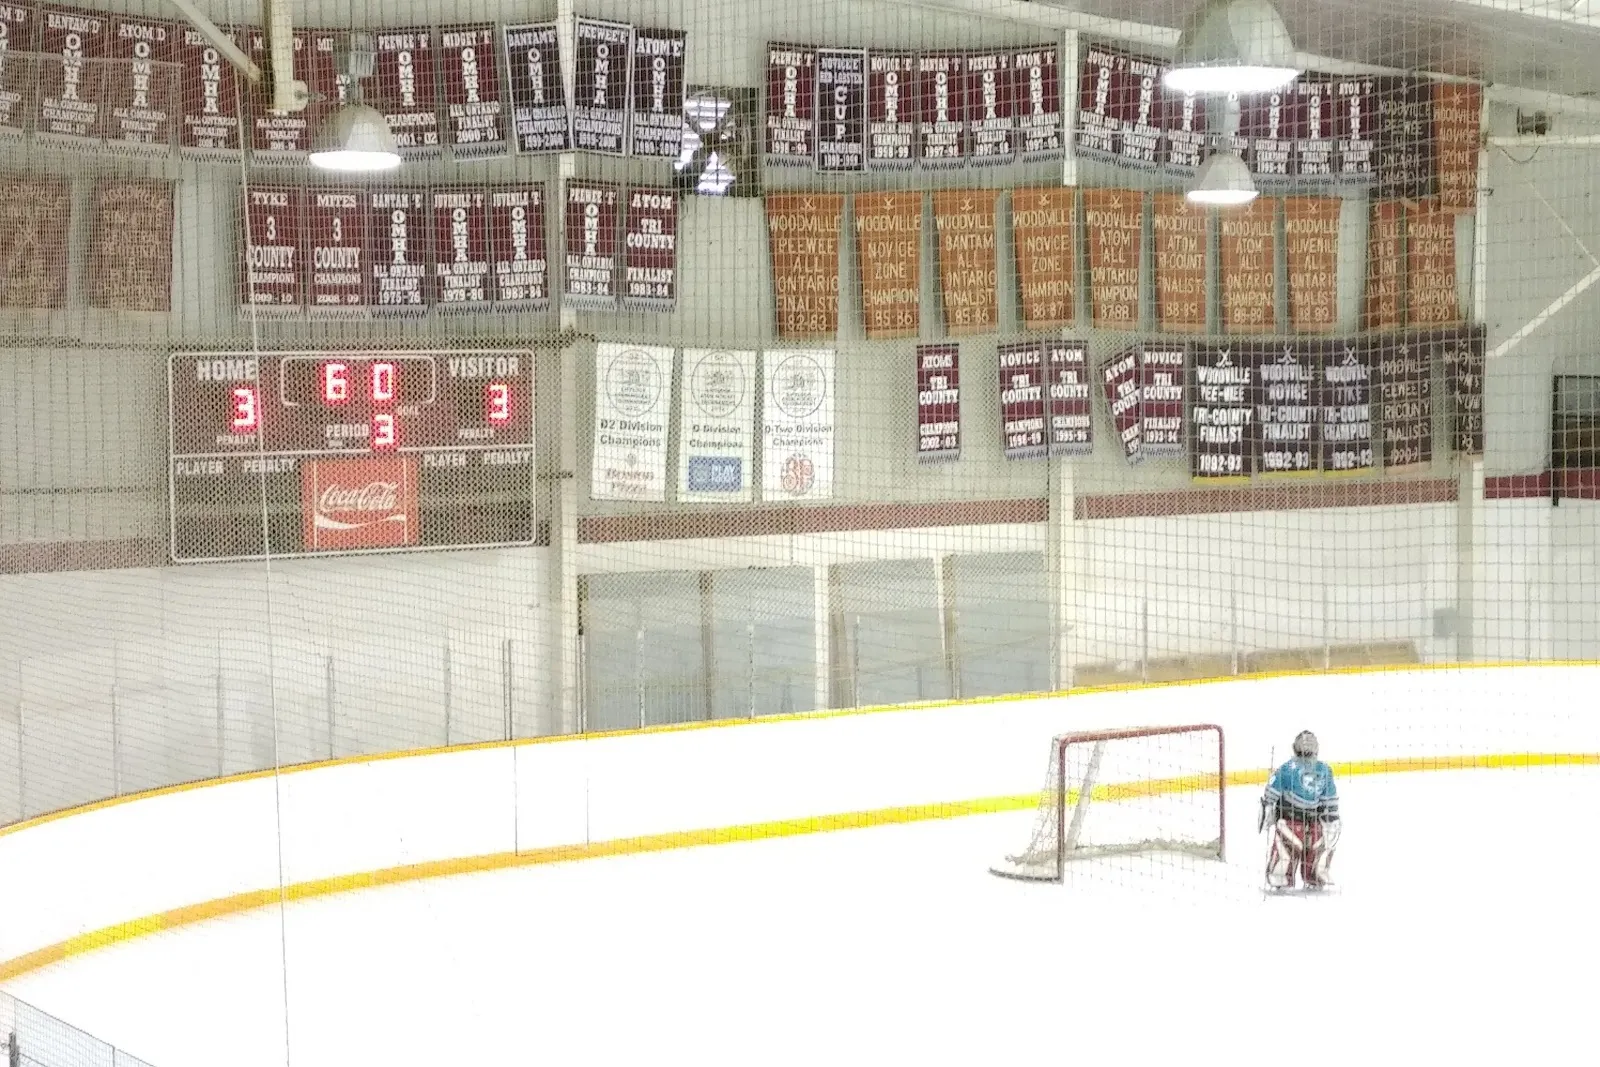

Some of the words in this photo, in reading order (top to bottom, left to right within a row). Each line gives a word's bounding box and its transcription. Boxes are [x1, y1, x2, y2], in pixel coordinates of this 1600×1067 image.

[119, 24, 153, 39] ATOM
[508, 31, 549, 47] BANTAM
[579, 24, 617, 42] PEEWEE
[378, 34, 414, 50] PEEWEE
[442, 32, 477, 48] MIDGET
[636, 37, 671, 55] ATOM
[770, 51, 802, 66] PEEWEE
[871, 58, 900, 71] NOVICE
[1016, 53, 1041, 69] ATOM
[1339, 82, 1360, 95] ATOM
[43, 98, 58, 108] ALL
[113, 107, 128, 118] ALL
[185, 115, 201, 126] ALL
[385, 112, 437, 127] CHAMPIONS
[256, 118, 271, 128] ALL
[272, 119, 307, 129] ONTARIO
[457, 115, 494, 130] FINALIST
[265, 130, 300, 140] FINALIST
[252, 192, 288, 207] TYKE
[317, 194, 357, 209] MITES
[372, 193, 409, 209] BANTAM
[434, 193, 471, 208] JUVENILE
[492, 191, 529, 208] JUVENILE
[569, 188, 603, 204] PEEWEE
[631, 193, 673, 210] ATOM
[640, 217, 663, 234] TRI
[770, 214, 842, 232] WOODVILLE
[857, 214, 922, 232] WOODVILLE
[1086, 210, 1143, 229] WOODVILLE
[266, 215, 277, 241] 3
[332, 217, 342, 242] 3
[626, 232, 676, 250] COUNTY
[945, 233, 994, 251] BANTAM
[1026, 234, 1070, 252] NOVICE
[1099, 229, 1131, 246] ATOM
[1167, 234, 1198, 251] ATOM
[778, 237, 836, 255] PEEWEE
[867, 240, 916, 258] NOVICE
[1235, 237, 1263, 255] ATOM
[246, 245, 296, 269] COUNTY
[313, 246, 361, 270] COUNTY
[566, 254, 580, 267] ALL
[581, 256, 615, 270] ONTARIO
[957, 250, 981, 269] ALL
[1103, 247, 1126, 264] ALL
[1240, 254, 1261, 270] ALL
[373, 264, 389, 278] ALL
[389, 264, 426, 279] ONTARIO
[437, 262, 451, 276] ALL
[453, 260, 488, 275] ONTARIO
[496, 260, 511, 274] ALL
[511, 258, 547, 273] ONTARIO
[793, 256, 823, 273] ALL
[875, 261, 907, 280] ZONE
[1031, 255, 1062, 274] ZONE
[313, 272, 362, 286] CHAMPIONS
[444, 274, 481, 289] FINALIST
[499, 272, 544, 287] CHAMPIONS
[569, 267, 611, 283] CHAMPIONS
[627, 267, 674, 283] FINALIST
[946, 270, 998, 288] ONTARIO
[1092, 267, 1139, 284] ONTARIO
[1226, 272, 1274, 290] ONTARIO
[381, 277, 418, 291] FINALIST
[570, 280, 609, 295] 1983-84
[629, 282, 669, 297] 1983-84
[777, 275, 840, 292] ONTARIO
[378, 290, 421, 305] 1975-76
[443, 287, 484, 303] 1979-80
[501, 285, 542, 300] 1983-84
[788, 314, 827, 331] 82-83
[922, 354, 954, 370] ATOMS
[1000, 350, 1040, 369] NOVICE
[1051, 348, 1084, 362] ATOM
[1143, 351, 1183, 365] NOVICE
[197, 359, 259, 381] HOME
[449, 356, 520, 378] VISITOR
[1104, 355, 1136, 383] ATOM
[1197, 364, 1251, 384] WOODVILLE
[1259, 363, 1315, 382] WOODVILLE
[929, 375, 949, 391] TRI
[1011, 373, 1030, 390] TRI
[1059, 370, 1078, 385] TRI
[1153, 372, 1173, 387] TRI
[1001, 385, 1042, 405] COUNTY
[1050, 383, 1089, 399] COUNTY
[1117, 377, 1135, 399] TRI
[1143, 385, 1183, 400] COUNTY
[1200, 385, 1245, 402] PEE-WEE
[1268, 383, 1309, 401] NOVICE
[488, 383, 510, 420] 3
[919, 388, 959, 406] COUNTY
[232, 387, 256, 428] 3
[1051, 414, 1091, 429] CHAMPIONS
[1143, 416, 1182, 430] FINALIST
[1192, 406, 1253, 426] TRI-COUNTY
[325, 423, 371, 439] PERIOD
[373, 412, 396, 446] 3
[458, 427, 496, 440] PENALTY
[600, 418, 616, 432] D2
[618, 419, 663, 433] Division
[692, 423, 701, 434] D
[703, 423, 742, 435] Division
[796, 423, 832, 434] Division
[919, 421, 959, 436] CHAMPIONS
[1004, 417, 1044, 435] CHAMPIONS
[1262, 422, 1311, 441] FINALIST
[216, 433, 257, 445] PENALTY
[599, 434, 661, 449] Champions
[772, 436, 824, 448] Champions
[1199, 425, 1244, 444] FINALIST
[689, 438, 744, 450] Champions
[175, 460, 224, 475] PLAYER
[242, 458, 296, 474] PENALTY
[422, 452, 468, 468] PLAYER
[483, 450, 533, 466] PENALTY
[319, 481, 400, 512] Coca-Cola
